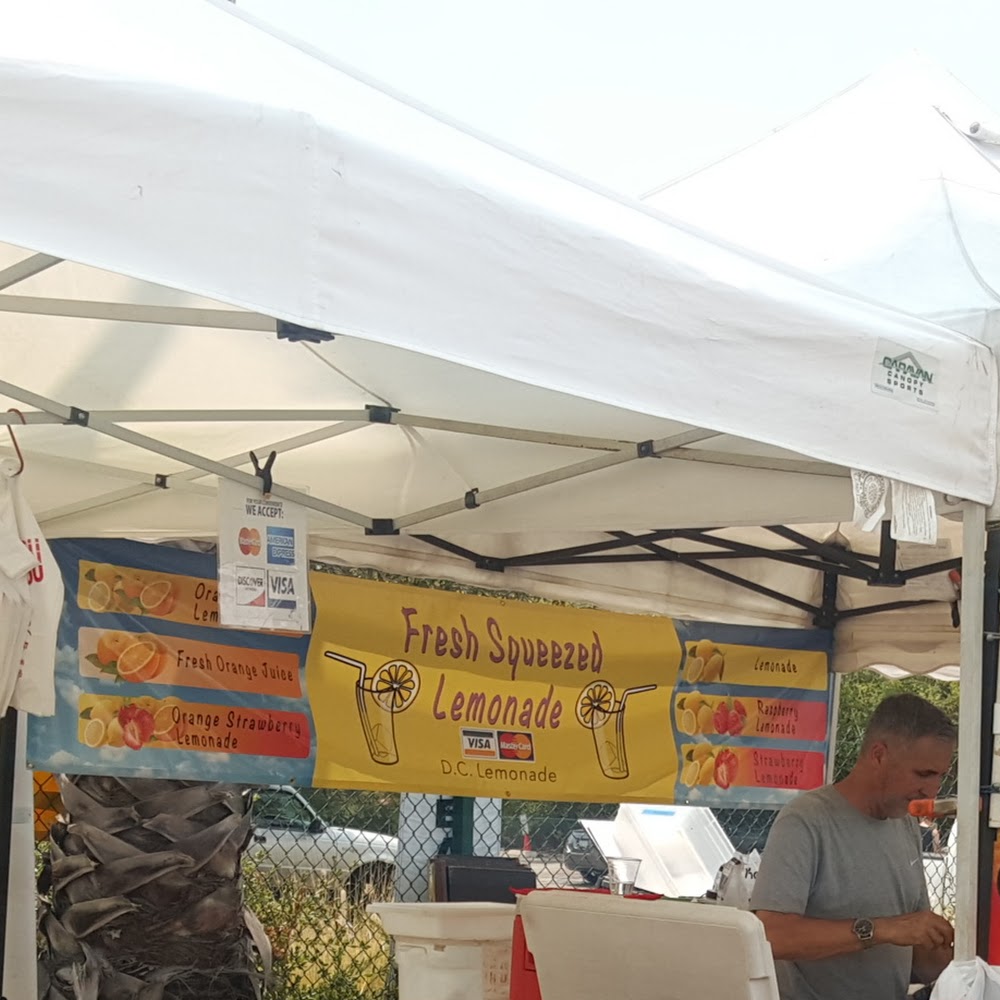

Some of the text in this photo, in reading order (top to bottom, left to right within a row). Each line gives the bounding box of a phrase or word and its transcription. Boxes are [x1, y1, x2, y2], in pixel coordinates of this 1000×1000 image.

[883, 356, 933, 384] CARAVAN
[887, 370, 924, 388] CANOPY
[886, 378, 924, 396] SPORTS
[245, 503, 284, 519] WE ACCEPT:
[195, 582, 218, 602] Ora
[237, 576, 264, 588] DISCOVER
[270, 576, 295, 595] VISA
[401, 606, 603, 681] Fresh Squeezed
[176, 650, 293, 682] Fresh Orange Juice
[754, 656, 798, 674] Lemonade
[432, 673, 563, 730] Lemonade
[756, 699, 799, 722] Raspberry
[172, 706, 301, 739] Orange Strawberry
[755, 718, 796, 735] Lemonade
[176, 728, 238, 749] Lemonade
[467, 737, 492, 749] VISA
[441, 759, 557, 782] D.C. Lemonade
[752, 750, 804, 773] Strawberry
